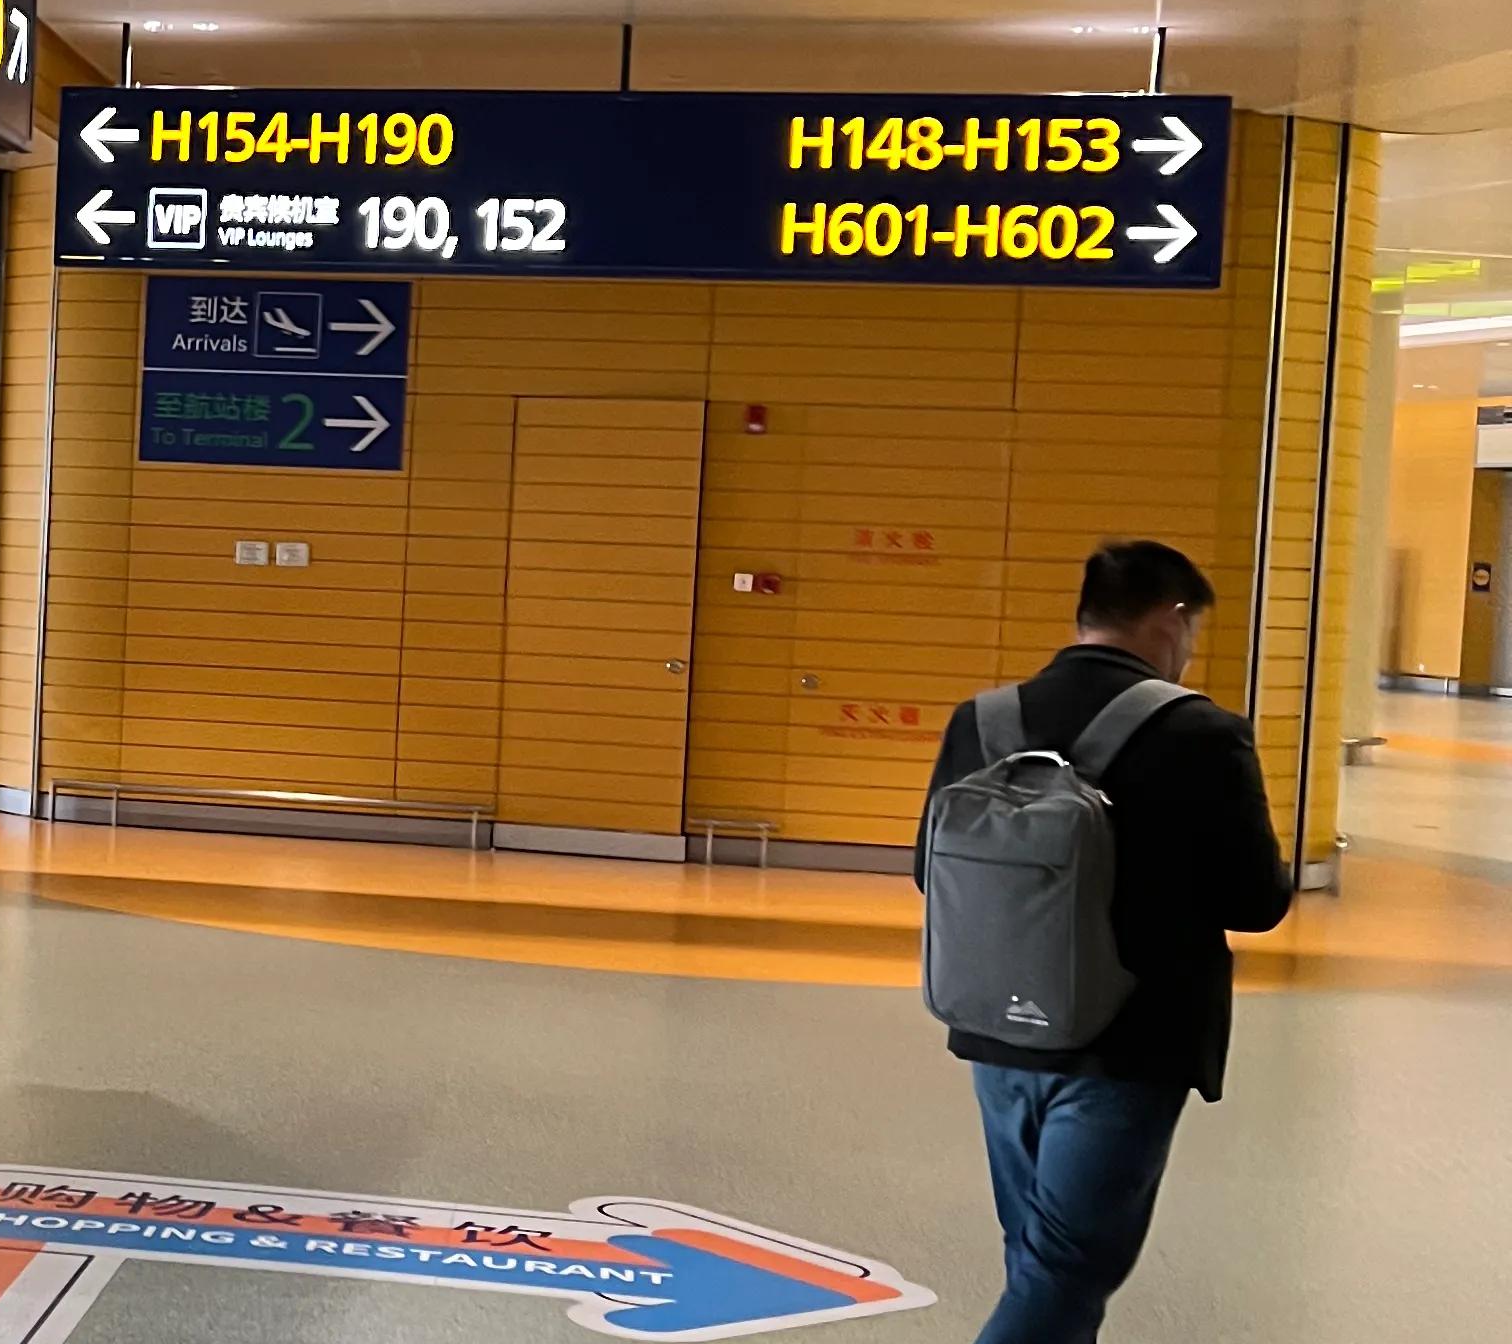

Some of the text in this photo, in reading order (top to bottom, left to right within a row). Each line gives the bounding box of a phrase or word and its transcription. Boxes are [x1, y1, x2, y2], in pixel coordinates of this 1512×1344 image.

[151, 110, 454, 166] H154-H190
[788, 116, 1121, 173] H148-H153
[154, 203, 202, 235] VIP
[217, 226, 315, 252] VIP Lounges
[358, 195, 567, 259] 190, 152
[780, 202, 1115, 261] H601-H602
[189, 296, 249, 325] 到达
[172, 333, 248, 353] Arrivals
[150, 427, 269, 449] To Terminal
[278, 393, 315, 450] 2
[248, 1233, 289, 1251] &
[304, 1238, 675, 1287] RESTAURANT
